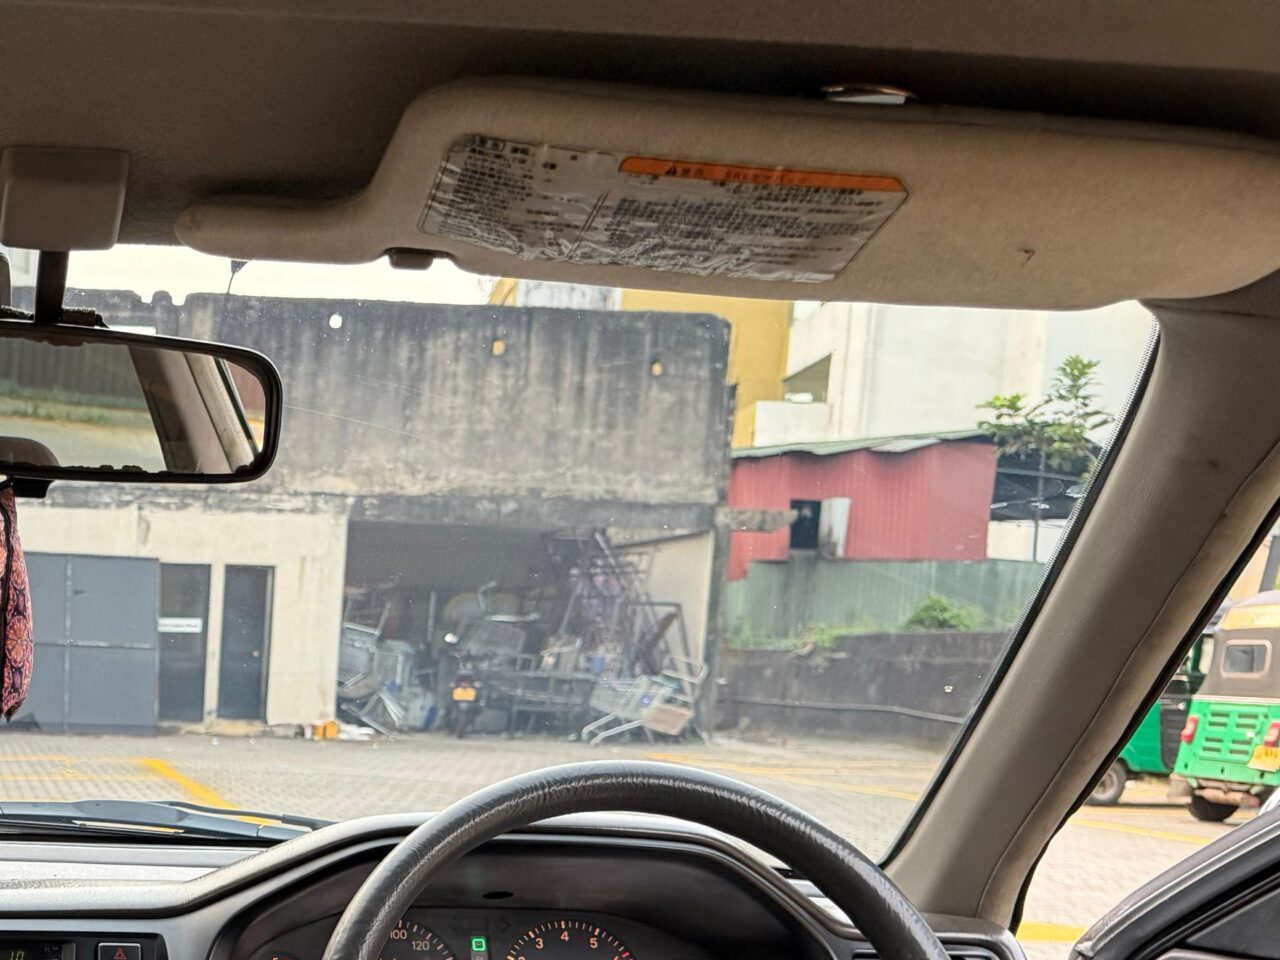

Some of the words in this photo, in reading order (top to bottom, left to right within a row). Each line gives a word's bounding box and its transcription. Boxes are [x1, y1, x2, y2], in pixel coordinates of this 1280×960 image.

[561, 931, 569, 942] 4
[412, 941, 430, 951] 120
[535, 938, 544, 949] 3
[590, 938, 598, 949] 5
